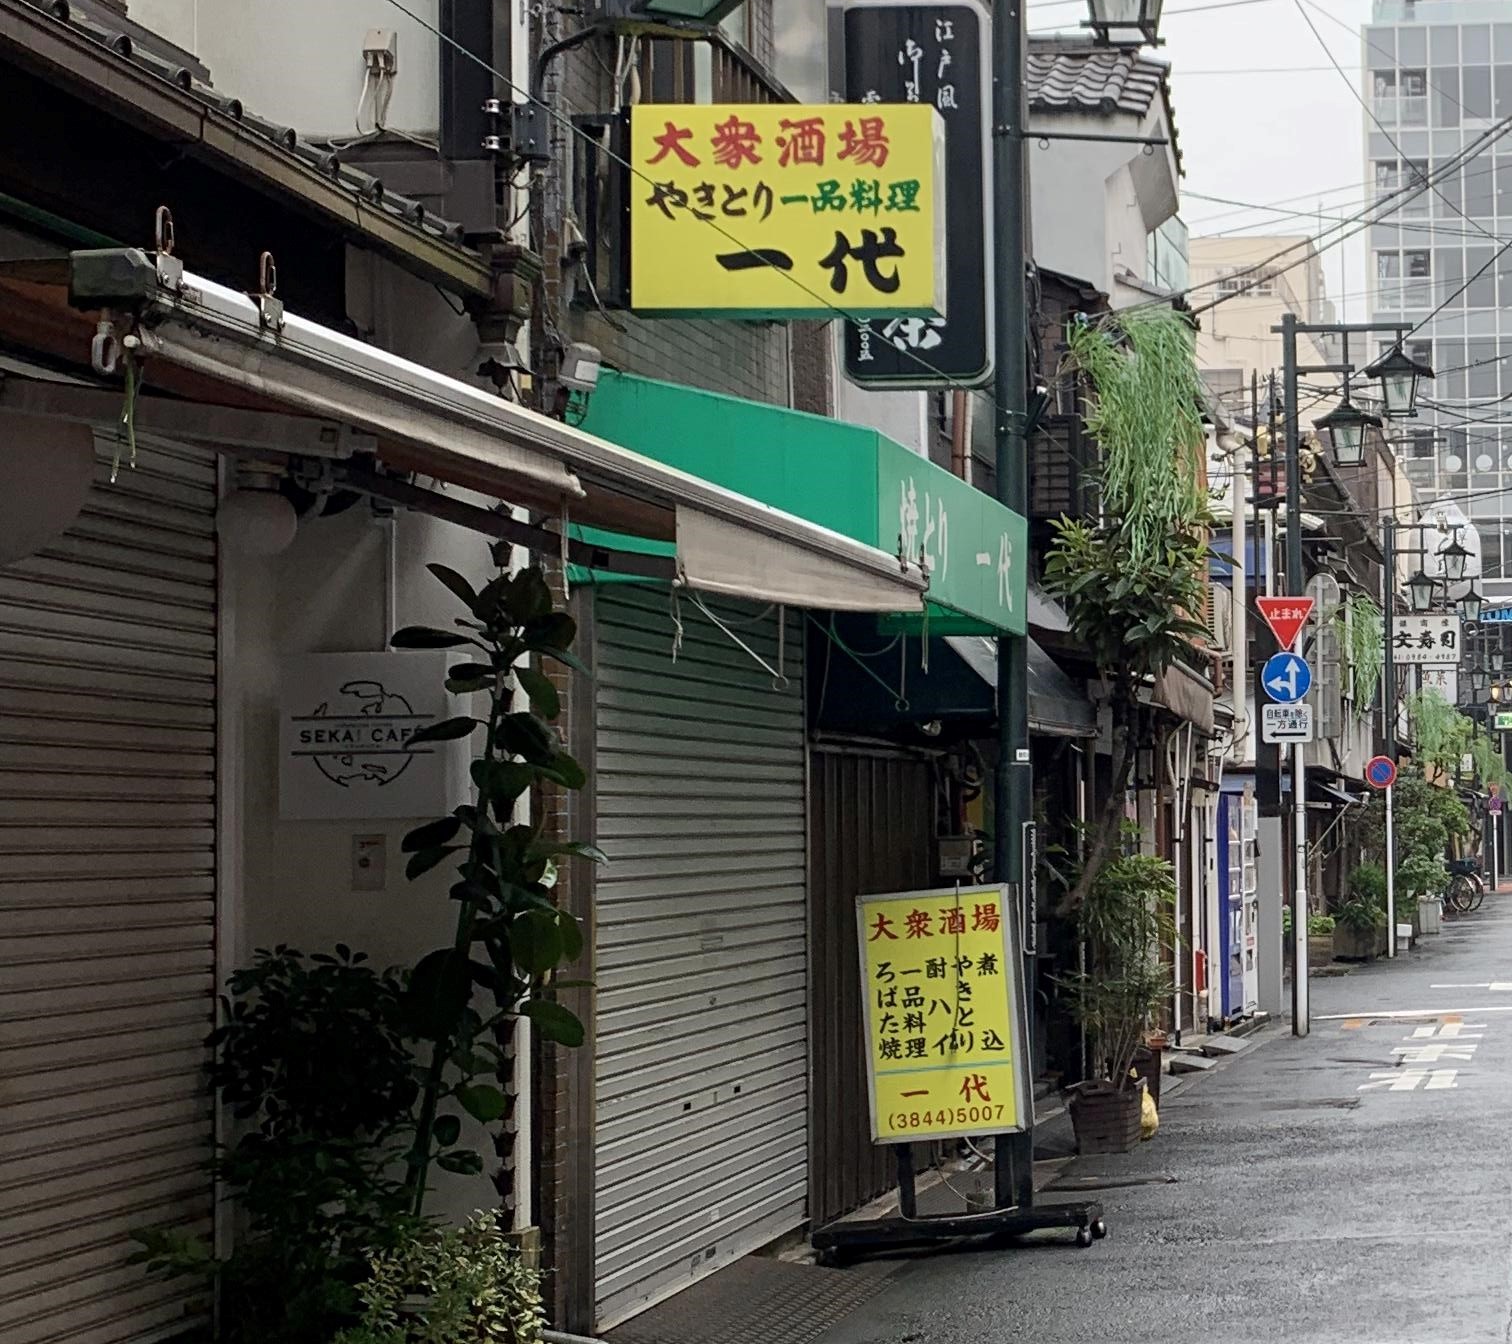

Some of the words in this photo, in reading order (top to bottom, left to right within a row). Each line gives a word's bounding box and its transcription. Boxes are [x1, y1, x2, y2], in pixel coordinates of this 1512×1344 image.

[645, 115, 891, 169] 大衆酒場
[715, 227, 906, 294] 一代
[1269, 607, 1304, 620] 止まれ
[1266, 709, 1308, 720] 自転車を除く
[1266, 720, 1308, 729] 一方通行
[868, 903, 1001, 942] 大衆酒場
[900, 1073, 991, 1103] 一代
[888, 1104, 1004, 1130] (3844)5007
